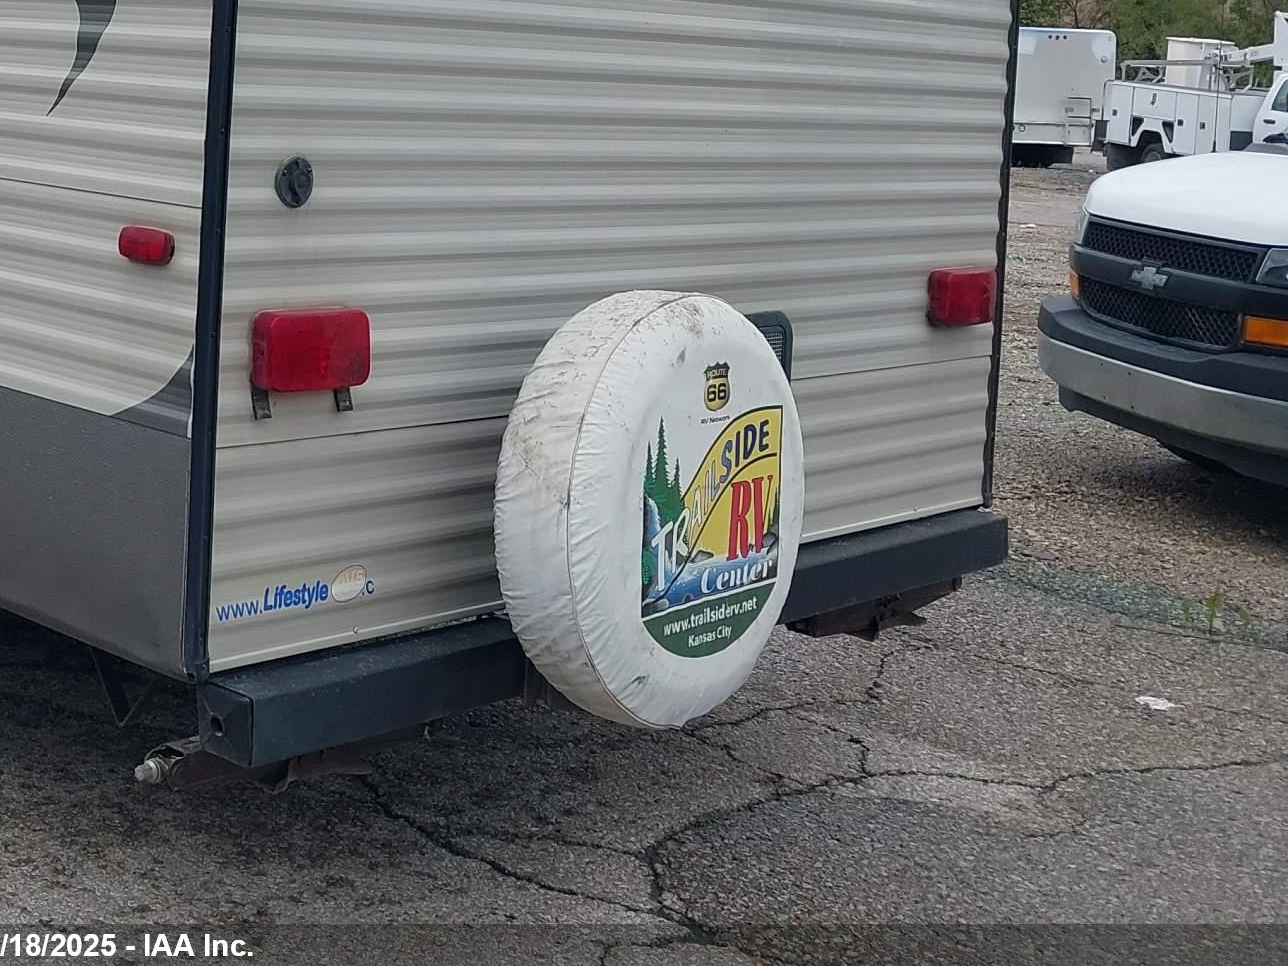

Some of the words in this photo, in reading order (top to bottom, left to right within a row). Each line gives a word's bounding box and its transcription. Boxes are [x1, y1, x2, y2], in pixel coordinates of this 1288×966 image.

[706, 369, 728, 379] ROUTE
[707, 383, 727, 402] 66
[652, 419, 770, 591] TRAILSIDE
[726, 475, 773, 561] RV
[700, 558, 773, 595] Center
[663, 598, 757, 636] www.trailsiderv.net
[688, 632, 716, 647] Kansas
[716, 626, 731, 641] City
